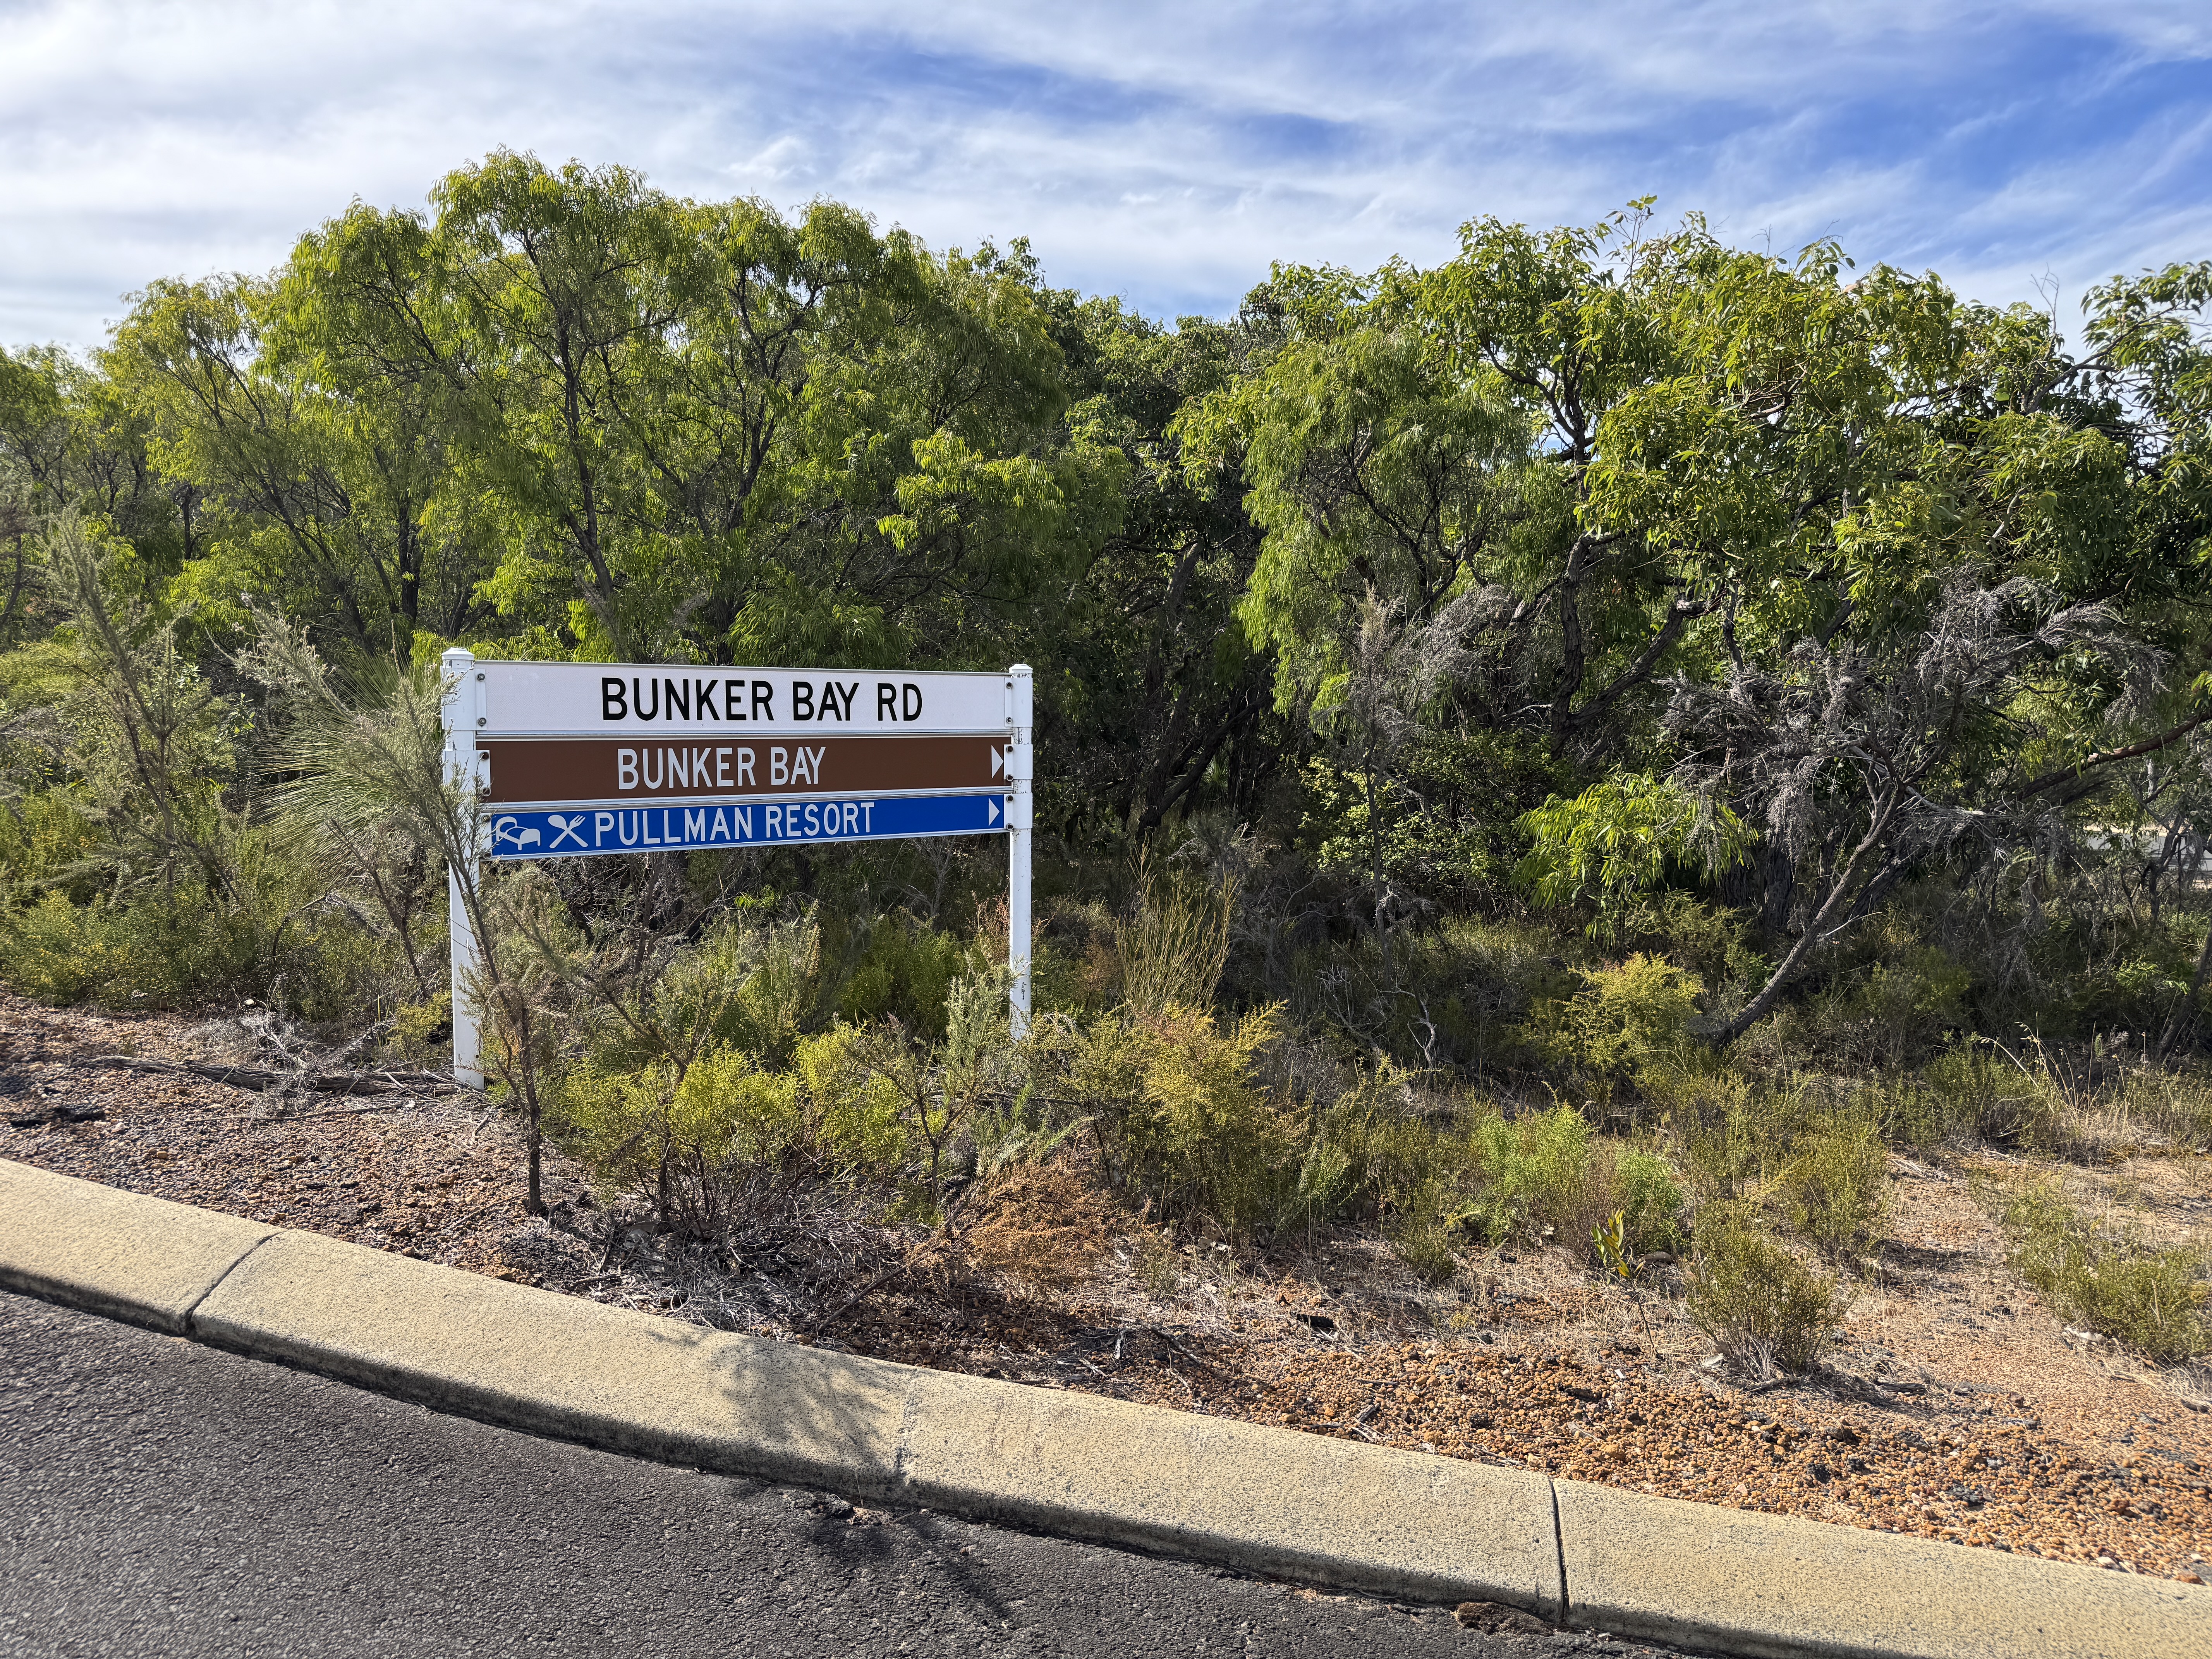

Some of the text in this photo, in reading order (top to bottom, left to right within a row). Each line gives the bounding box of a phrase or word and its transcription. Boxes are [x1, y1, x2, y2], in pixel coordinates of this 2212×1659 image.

[602, 677, 922, 721] BUNKER BAY RD
[618, 746, 826, 790] BUNKER BAY
[595, 802, 874, 847] PULLMAN RESORT
